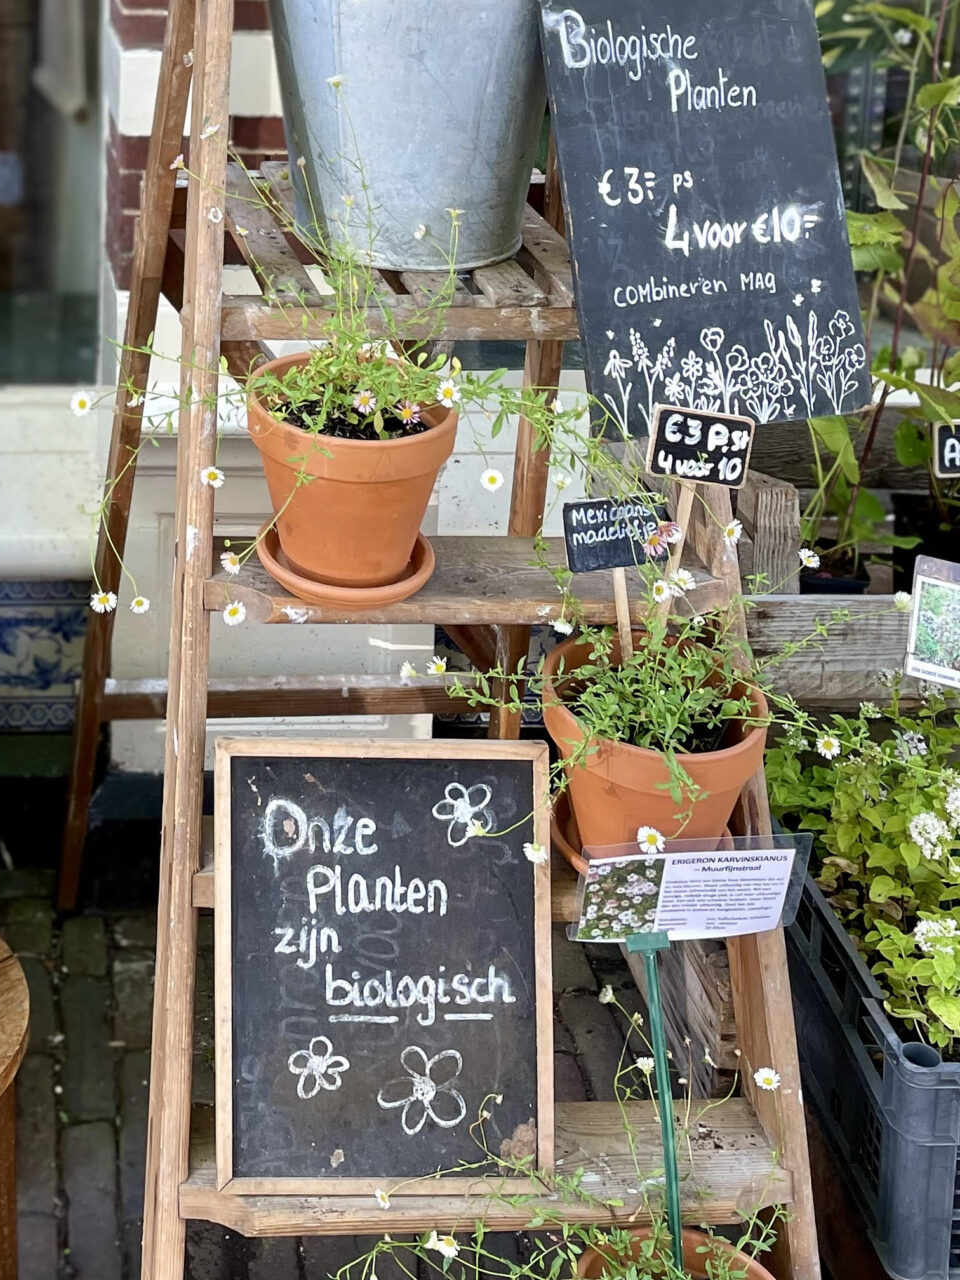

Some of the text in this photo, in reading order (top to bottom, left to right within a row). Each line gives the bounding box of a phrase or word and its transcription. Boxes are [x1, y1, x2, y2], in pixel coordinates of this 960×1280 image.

[559, 8, 699, 82] Biologische
[669, 68, 757, 113] Planten
[657, 449, 674, 475] 4
[718, 455, 743, 481] 10
[262, 798, 379, 857] Onze
[671, 855, 789, 866] ERIGERON KARVINSKIANUS
[701, 864, 762, 873] Muurfijnstraal
[307, 864, 449, 917] Planten
[271, 916, 343, 970] zijn
[325, 963, 517, 1026] biologisch
